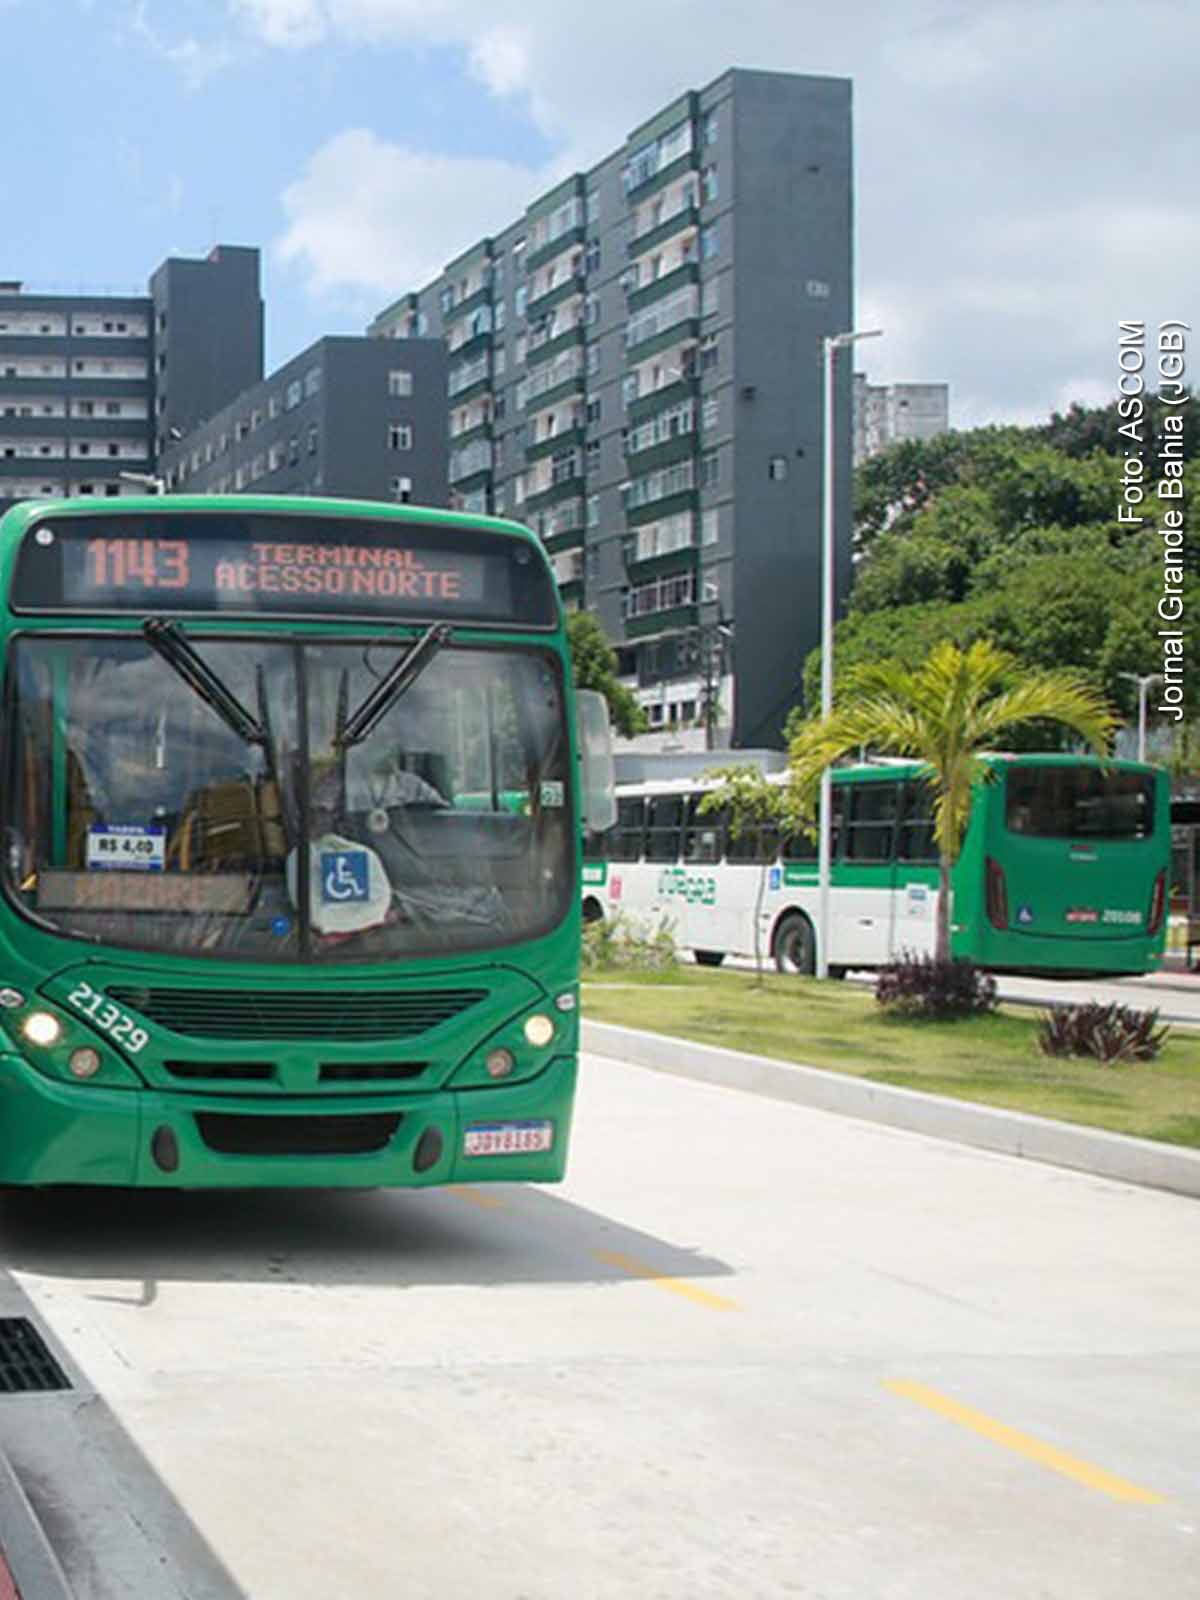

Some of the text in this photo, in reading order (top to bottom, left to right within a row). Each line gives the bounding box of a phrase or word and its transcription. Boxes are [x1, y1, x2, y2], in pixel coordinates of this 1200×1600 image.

[87, 538, 190, 588] 1143
[214, 559, 462, 599] ACESSO NORTE
[252, 543, 425, 571] TERMINAL
[67, 981, 150, 1054] 21329
